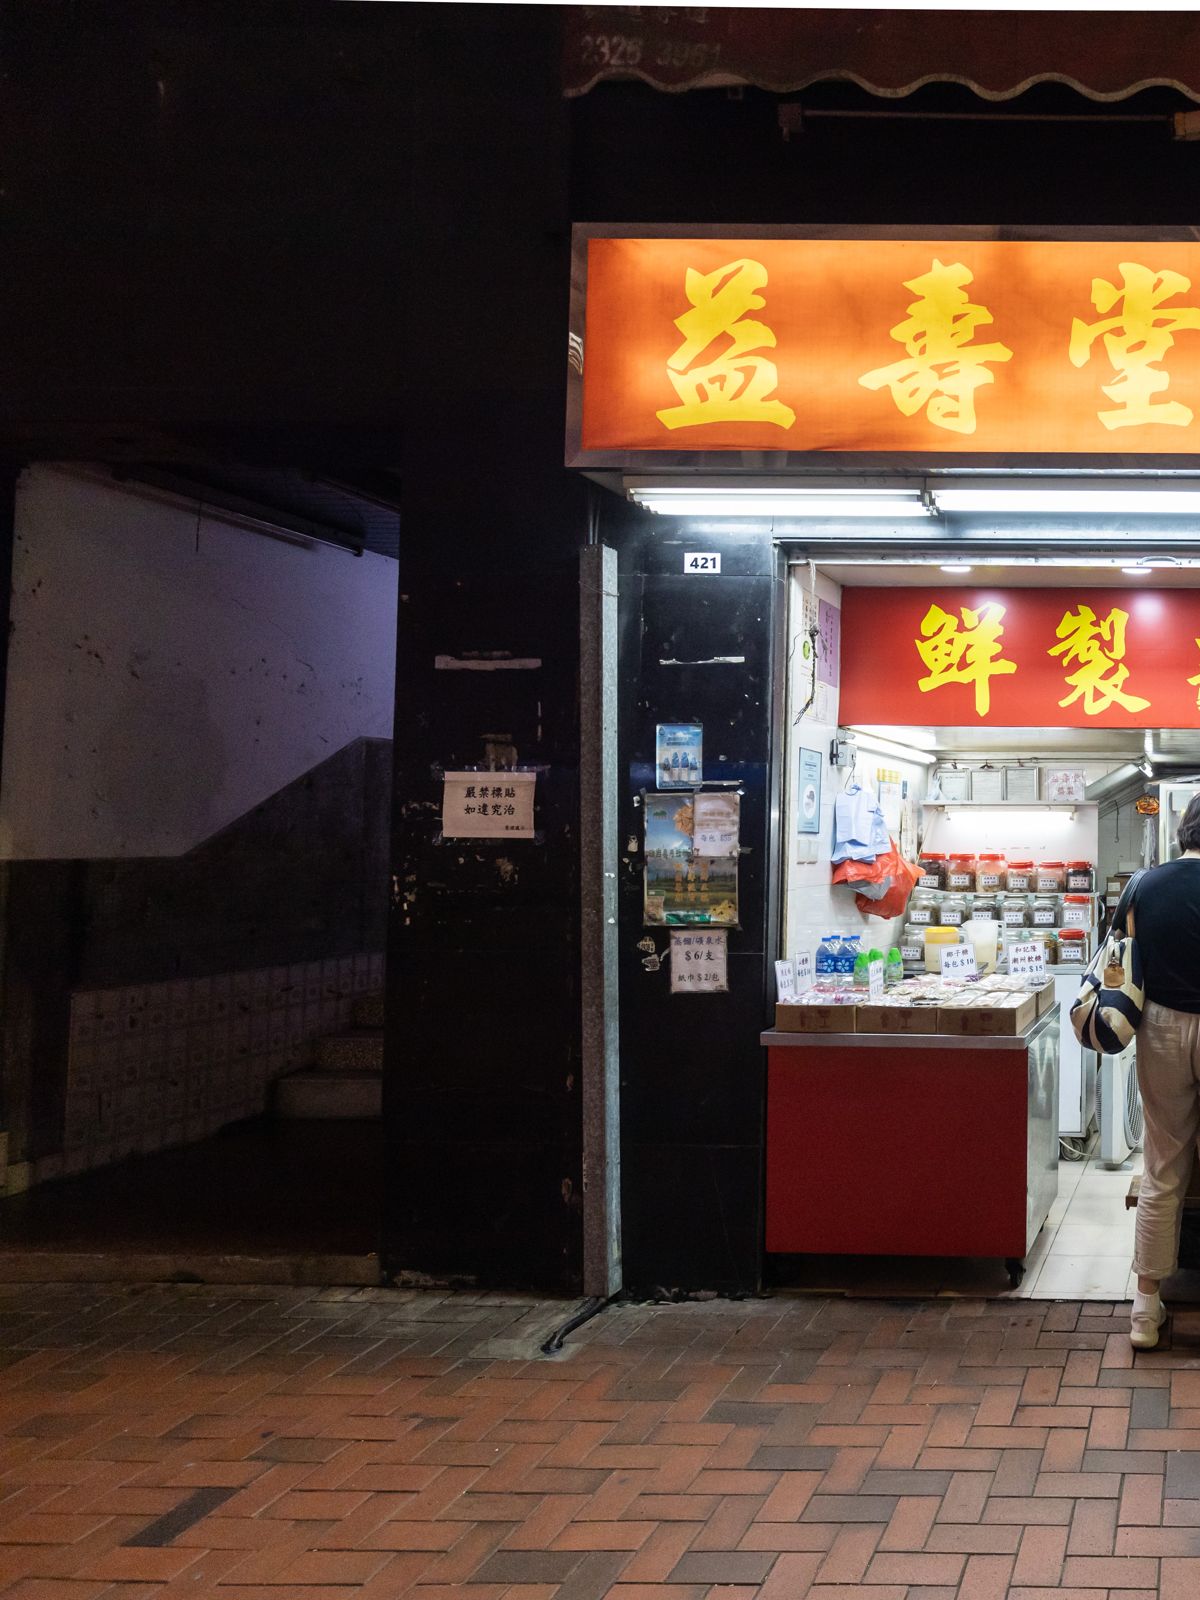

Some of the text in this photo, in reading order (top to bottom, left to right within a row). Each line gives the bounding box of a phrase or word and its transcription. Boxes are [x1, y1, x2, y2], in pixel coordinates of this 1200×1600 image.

[689, 557, 718, 569] 421
[464, 803, 516, 816] 如違究治
